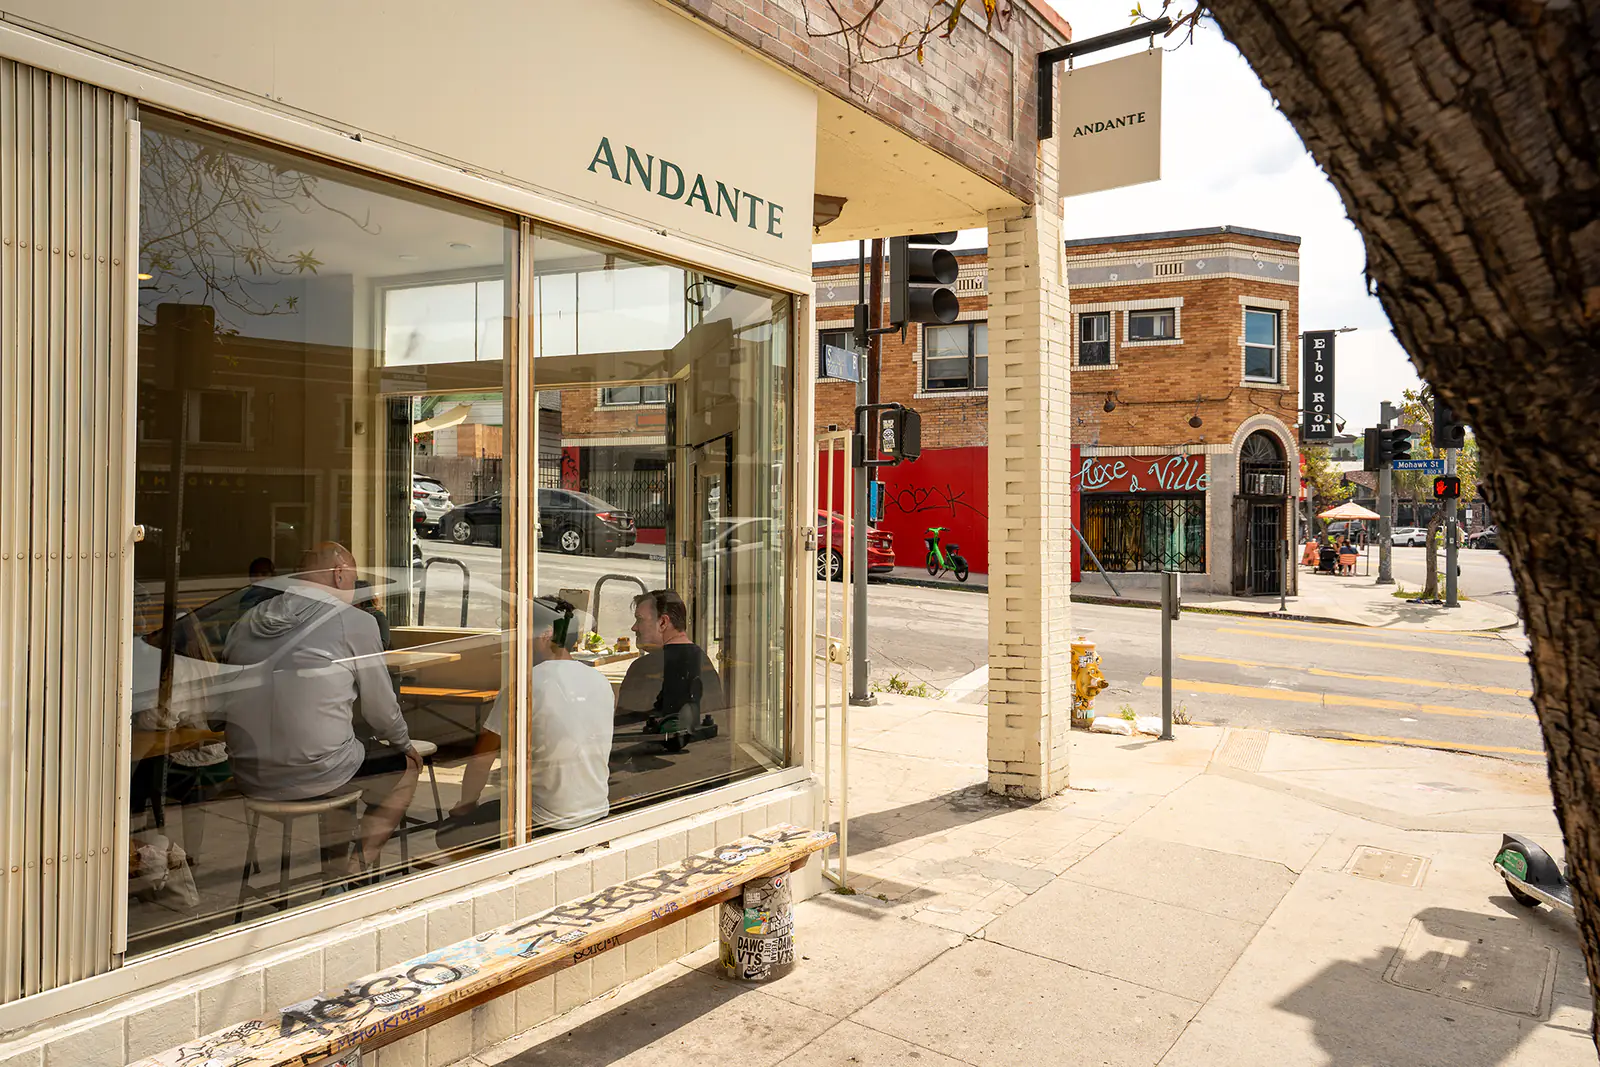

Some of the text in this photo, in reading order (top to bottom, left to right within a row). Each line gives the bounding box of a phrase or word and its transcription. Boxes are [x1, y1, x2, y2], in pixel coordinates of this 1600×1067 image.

[1073, 112, 1146, 137] ANDANTE
[587, 136, 784, 239] ANDANTE
[1311, 338, 1326, 432] Elbo Room
[1071, 458, 1129, 489] Luxe
[1147, 456, 1212, 491] Ville
[651, 901, 679, 921] ACAB
[737, 936, 764, 953] DAWG
[738, 949, 762, 966] VTS
